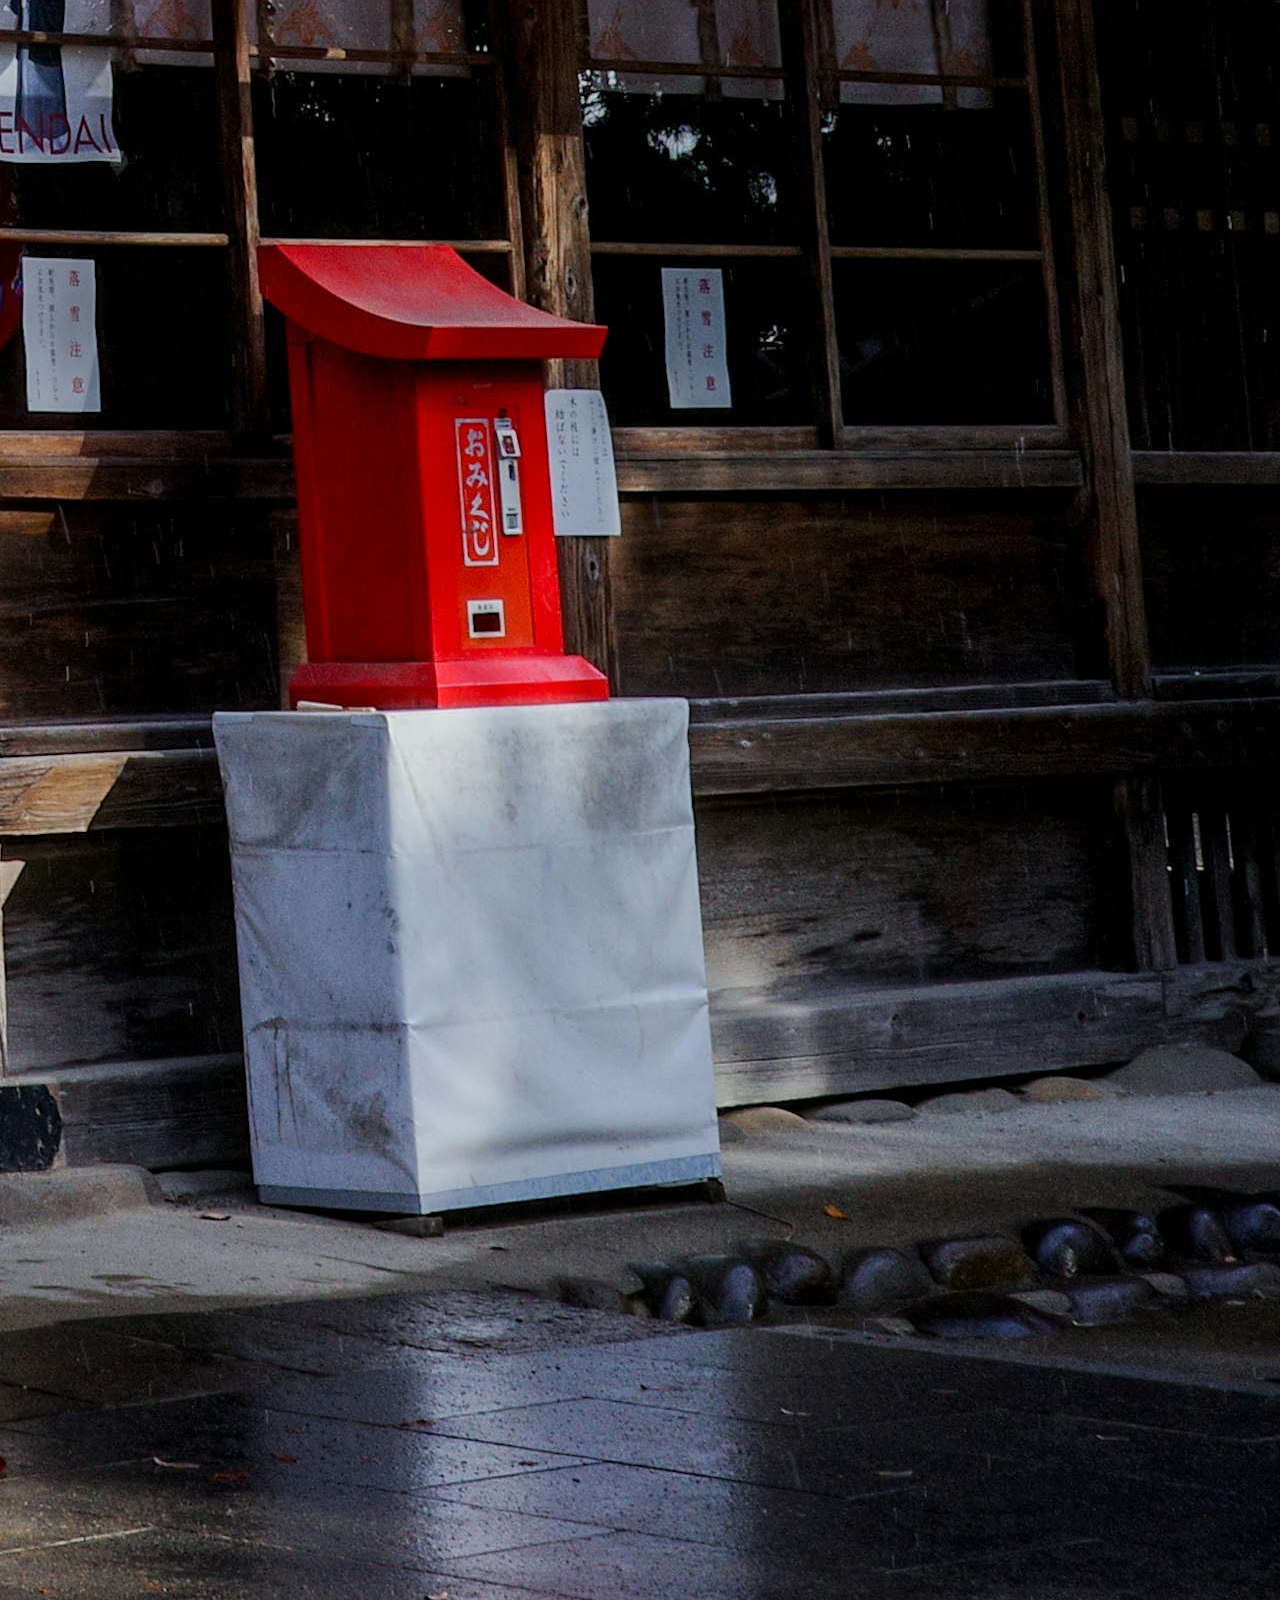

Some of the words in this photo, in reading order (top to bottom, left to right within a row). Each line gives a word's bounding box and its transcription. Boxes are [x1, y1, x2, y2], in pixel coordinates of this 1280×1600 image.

[68, 269, 86, 394] 落雪注意
[463, 428, 492, 558] おみくじ
